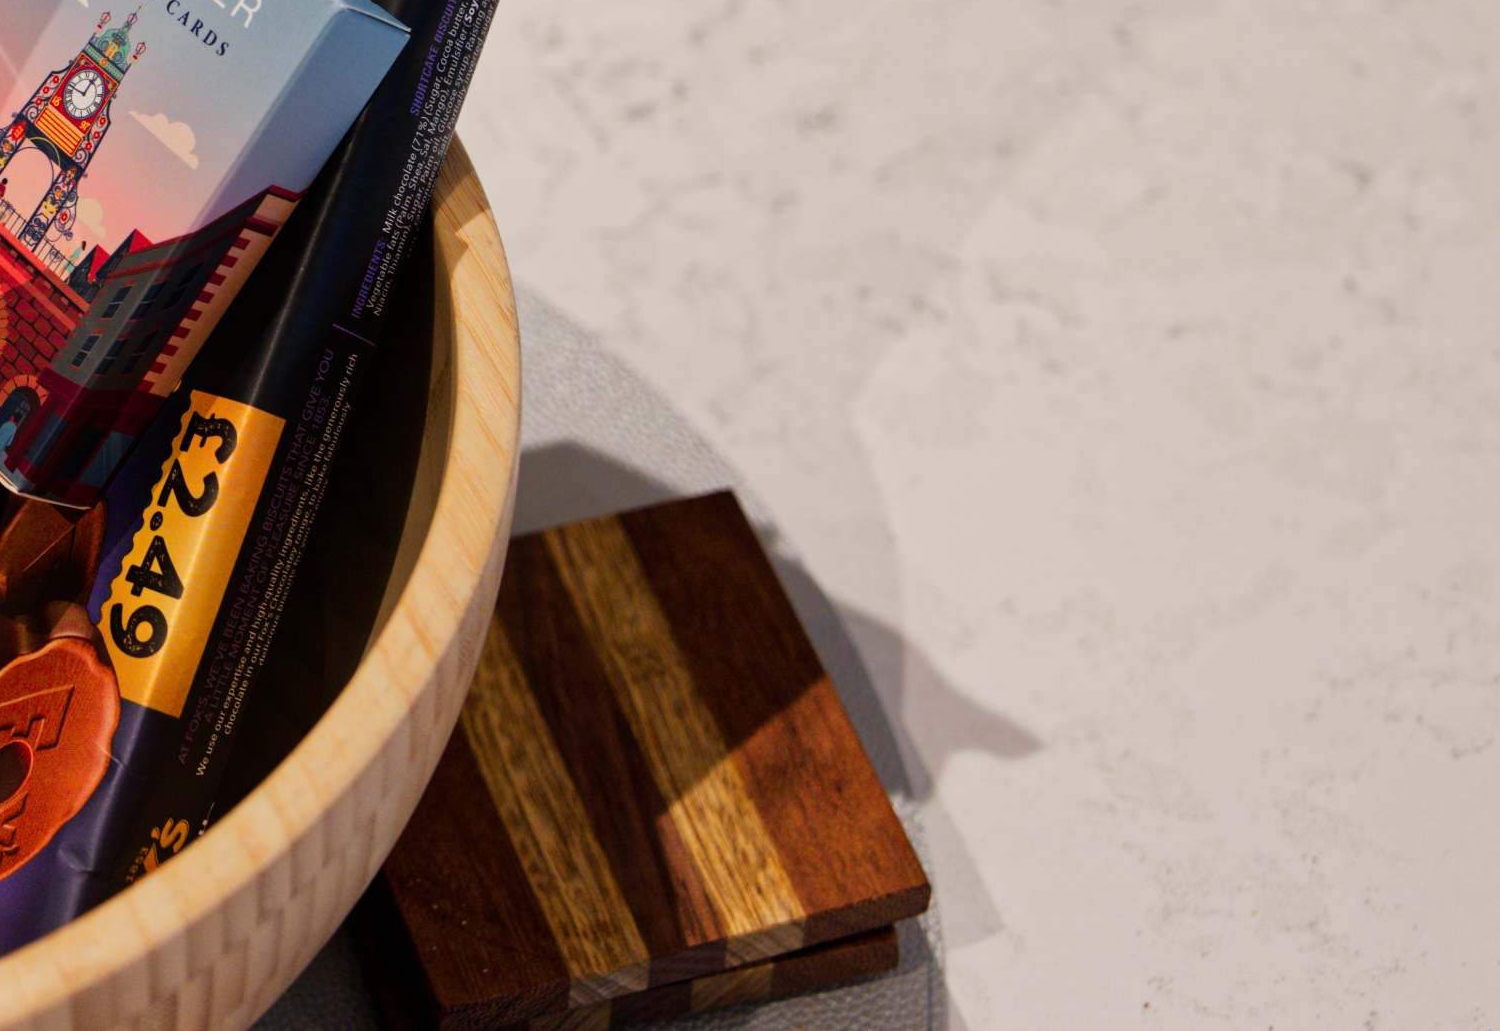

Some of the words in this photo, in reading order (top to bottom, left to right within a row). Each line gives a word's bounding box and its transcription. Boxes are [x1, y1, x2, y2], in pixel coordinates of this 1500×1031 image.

[166, 0, 230, 56] CARDS
[381, 207, 397, 233] Milk
[390, 151, 417, 206] chocolate
[410, 115, 430, 151] (71%)
[422, 74, 444, 116] (Sugar,
[435, 38, 453, 73] Cocoa
[447, 0, 469, 37] butter,
[419, 154, 434, 182] Palm
[436, 88, 457, 133] Glucose
[465, 9, 486, 51] Raising
[365, 251, 392, 309] Vegetable
[385, 229, 400, 250] fats
[394, 192, 414, 228] (Palm,
[407, 159, 425, 189] Shea,
[419, 136, 433, 156] Sal,
[443, 28, 468, 85] Emulsifier
[322, 401, 352, 461] fabulously
[222, 597, 245, 638] BEEN
[239, 534, 268, 594] BAKING
[262, 464, 292, 531] BISCUITS
[286, 423, 307, 462] THAT
[300, 384, 321, 422] GIVE
[313, 346, 335, 383] YOU
[308, 493, 316, 505] to
[311, 462, 327, 491] bake
[110, 411, 237, 658] £2.49
[195, 755, 209, 777] We
[205, 732, 218, 754] use
[214, 710, 226, 731] our
[222, 655, 247, 709] expertise
[243, 630, 256, 654] and
[303, 463, 318, 486] like
[312, 442, 326, 462] the
[321, 376, 351, 442] generously
[344, 351, 358, 375] rich
[208, 661, 232, 708] LITTLE
[228, 586, 260, 658] MOMENT
[255, 564, 269, 584] OF
[264, 480, 300, 558] PLEASURE
[293, 434, 316, 480] SINCE
[268, 546, 297, 609] Chocolatey
[244, 665, 254, 677] in
[249, 643, 262, 663] our
[223, 679, 249, 735] chocolate
